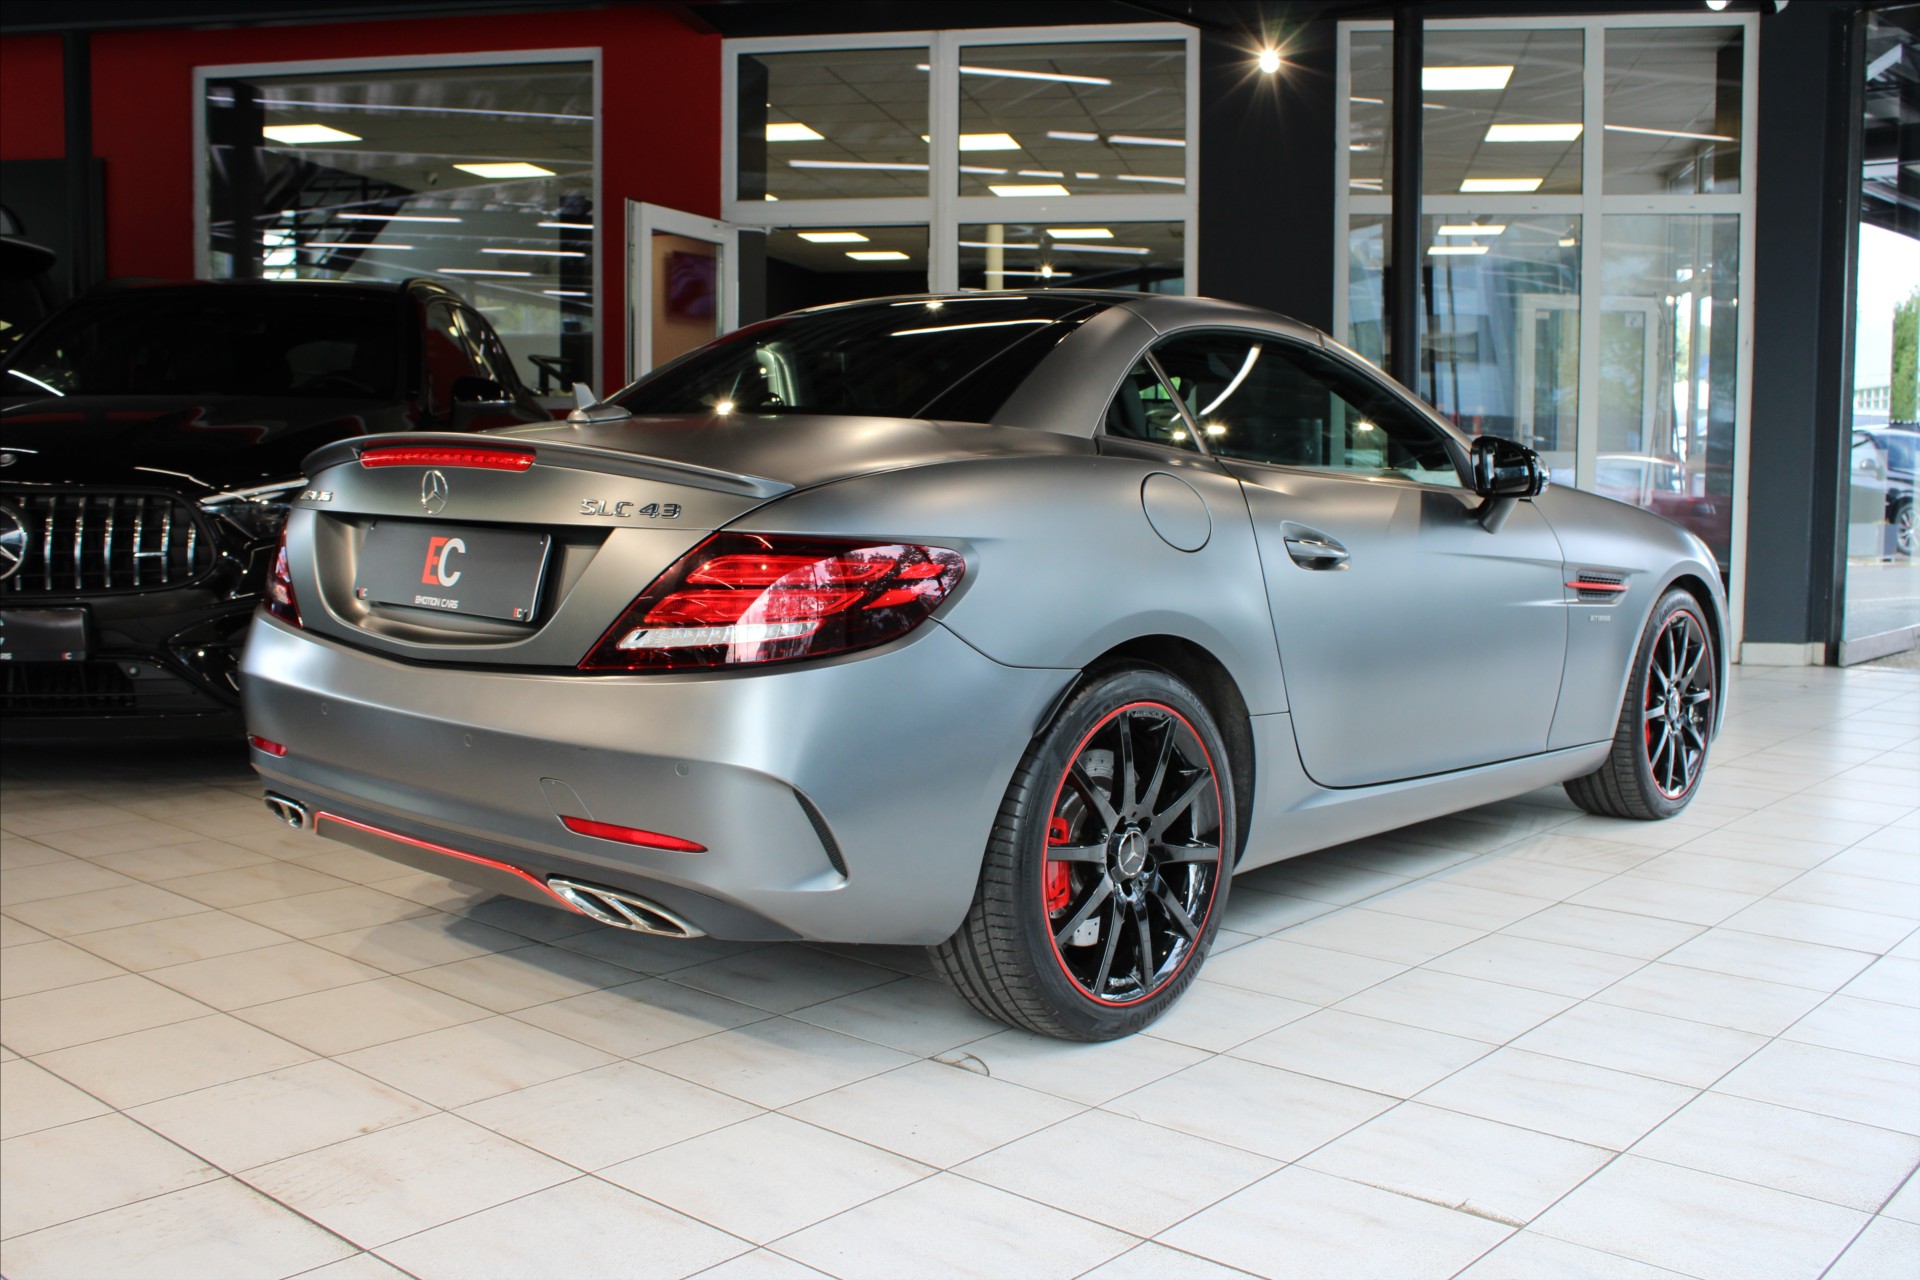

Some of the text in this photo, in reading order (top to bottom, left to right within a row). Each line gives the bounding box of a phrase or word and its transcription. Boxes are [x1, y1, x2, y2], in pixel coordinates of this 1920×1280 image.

[580, 498, 682, 519] SLC 43
[421, 536, 466, 588] EC
[414, 594, 459, 609] EMOTION CARS
